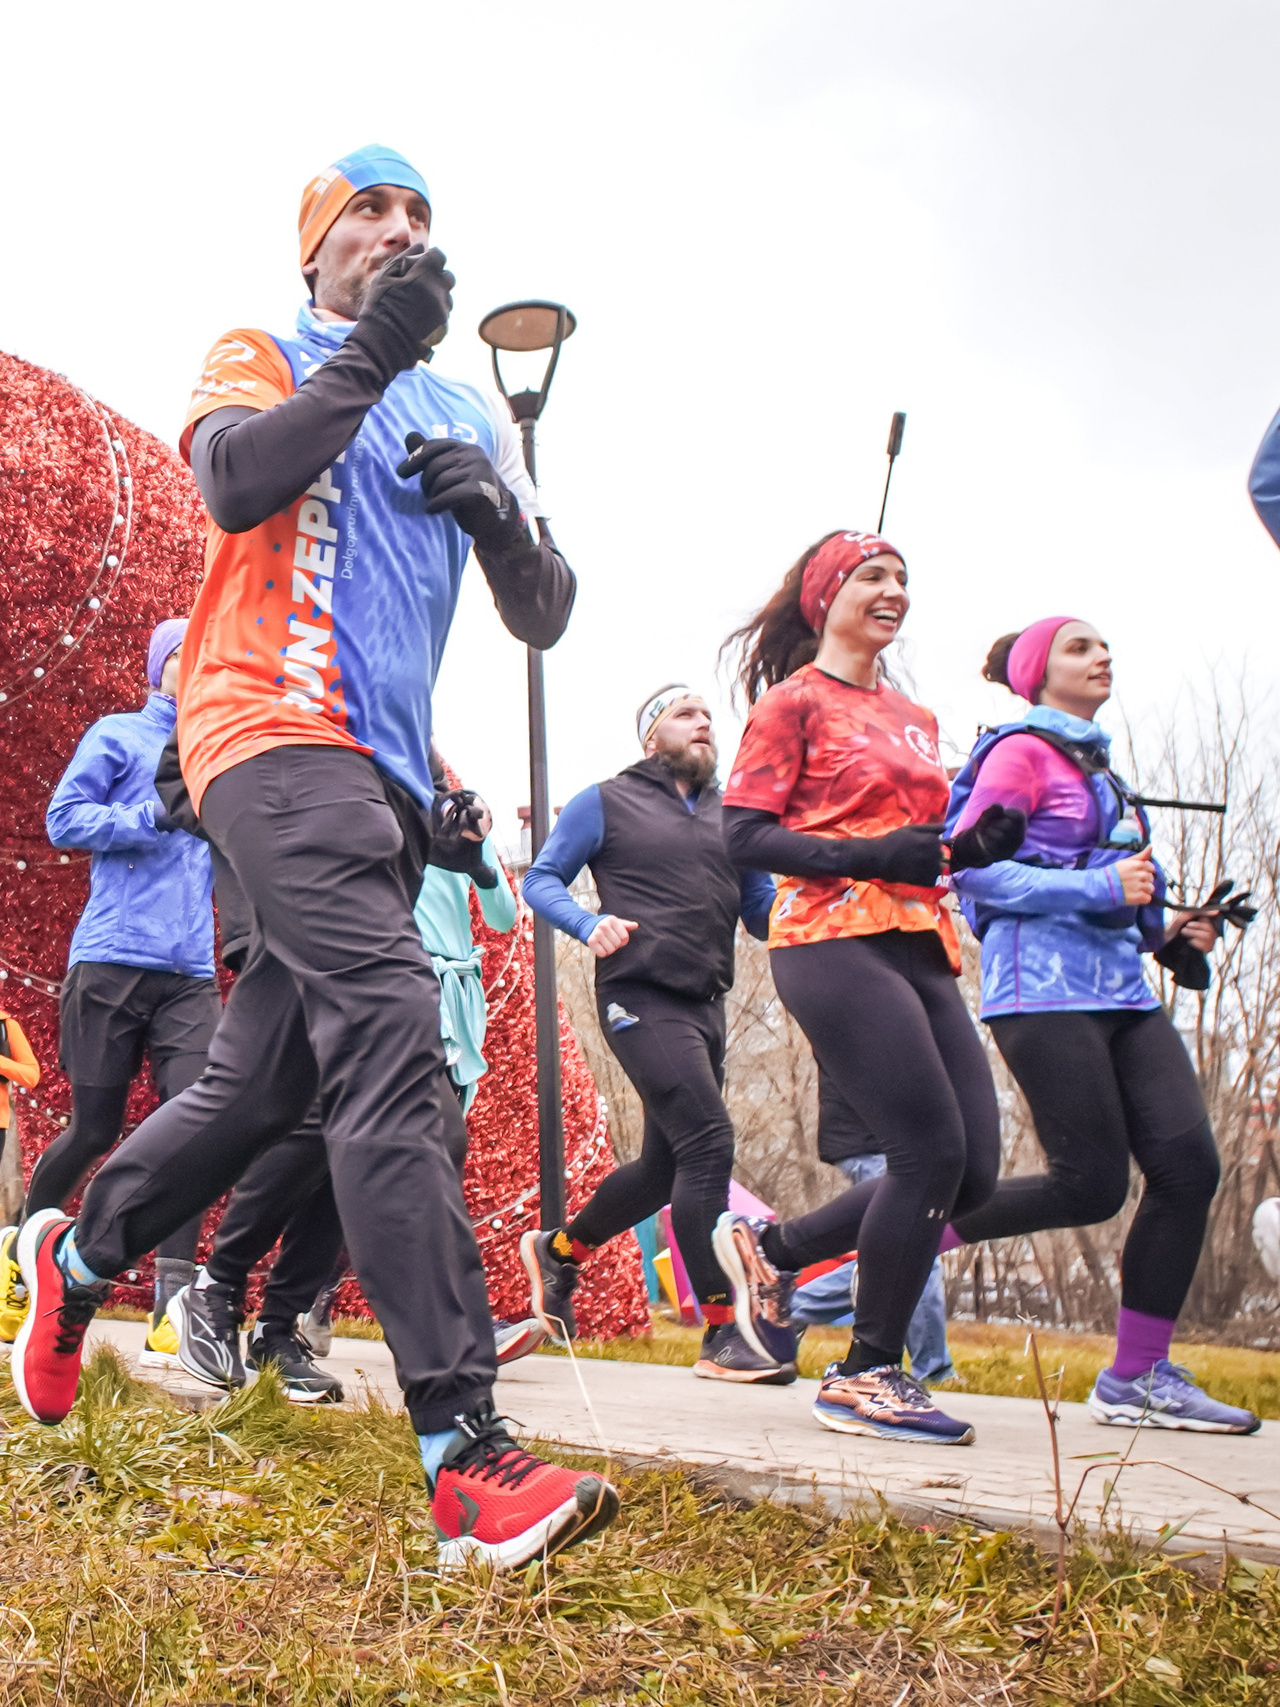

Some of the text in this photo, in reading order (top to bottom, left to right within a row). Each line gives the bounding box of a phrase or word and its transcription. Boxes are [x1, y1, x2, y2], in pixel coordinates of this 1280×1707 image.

[291, 449, 347, 614] ZEPP
[340, 437, 365, 580] Dolgoprudny running
